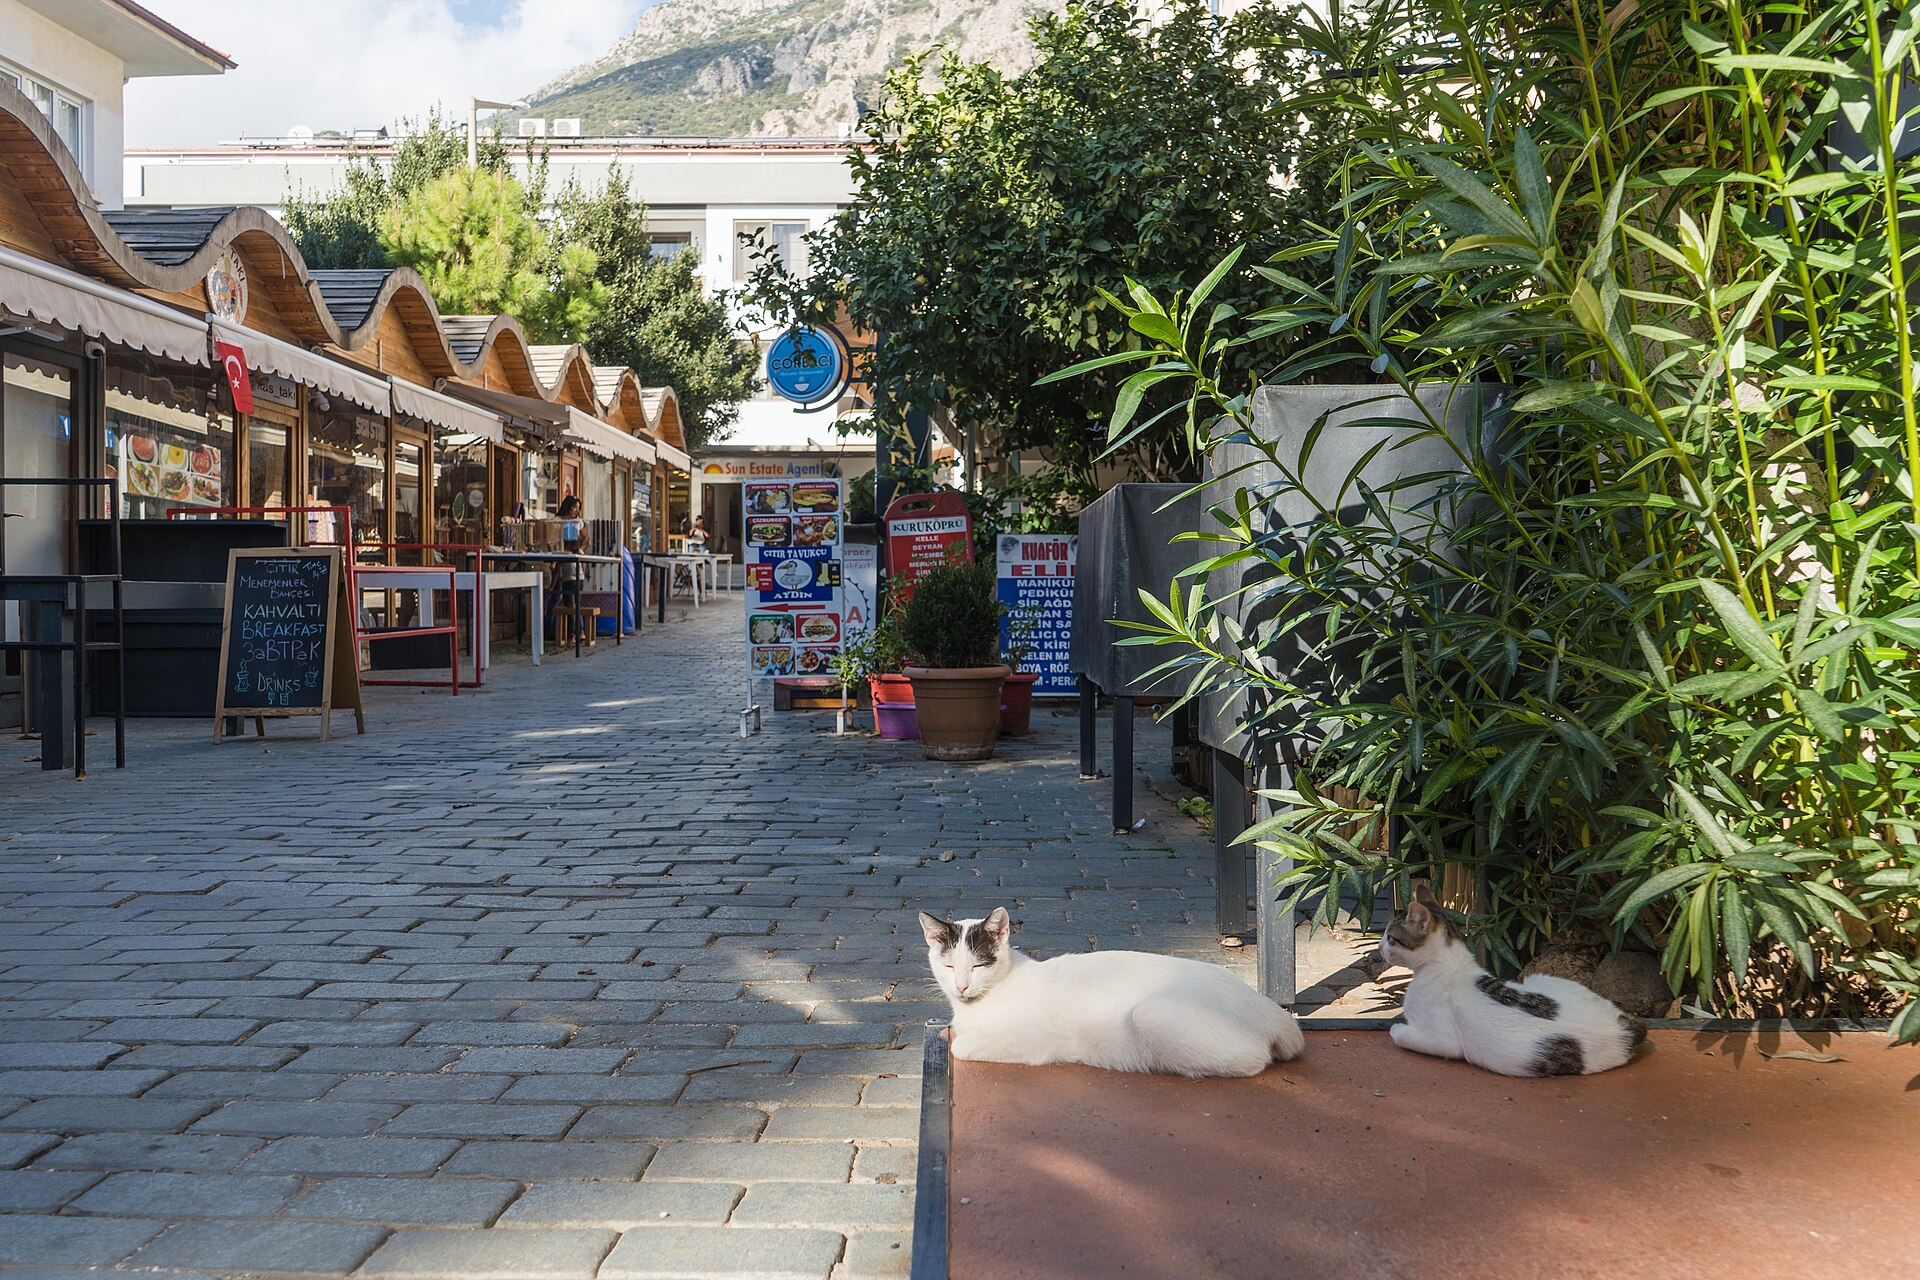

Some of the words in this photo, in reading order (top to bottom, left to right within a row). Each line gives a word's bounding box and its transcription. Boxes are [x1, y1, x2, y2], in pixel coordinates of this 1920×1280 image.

[771, 355, 833, 373] ÇORBCI
[725, 462, 746, 475] Sun
[750, 462, 784, 475] Estate
[764, 549, 786, 559] ÇITIR
[788, 549, 827, 559] TAVUKÇU
[1022, 538, 1069, 561] KUAFÖR
[1011, 561, 1077, 577] ELİ
[773, 591, 813, 599] AYDIN
[1043, 598, 1073, 608] AĞD
[243, 603, 321, 619] KAHVALTI
[242, 620, 325, 639] BREAKFAST
[1055, 620, 1072, 629] SA
[1060, 630, 1071, 639] O
[1043, 639, 1071, 649] KİR
[1055, 651, 1070, 661] MA
[1049, 661, 1073, 673] RÖF
